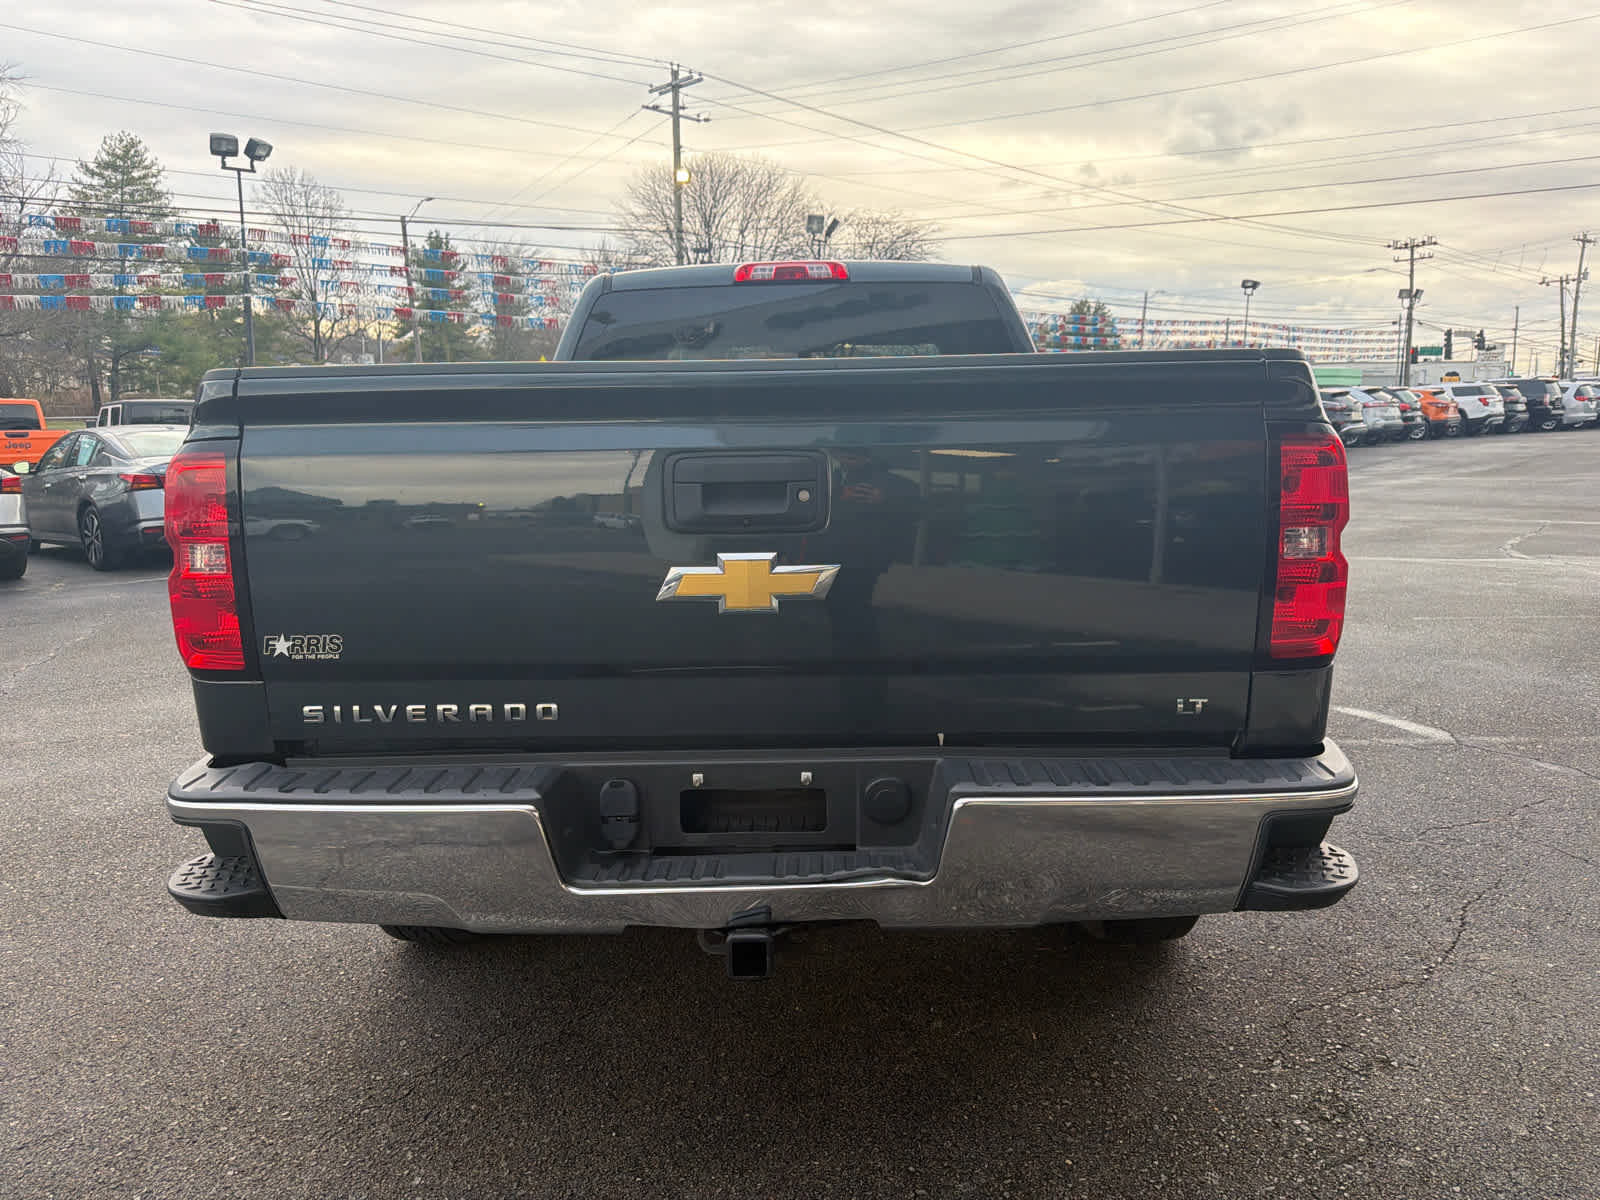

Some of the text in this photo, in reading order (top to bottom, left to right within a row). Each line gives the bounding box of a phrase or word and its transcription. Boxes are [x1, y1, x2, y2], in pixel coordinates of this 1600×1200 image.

[5, 440, 31, 449] Jeep
[302, 703, 559, 724] SILVERADO
[1176, 698, 1209, 714] LT
